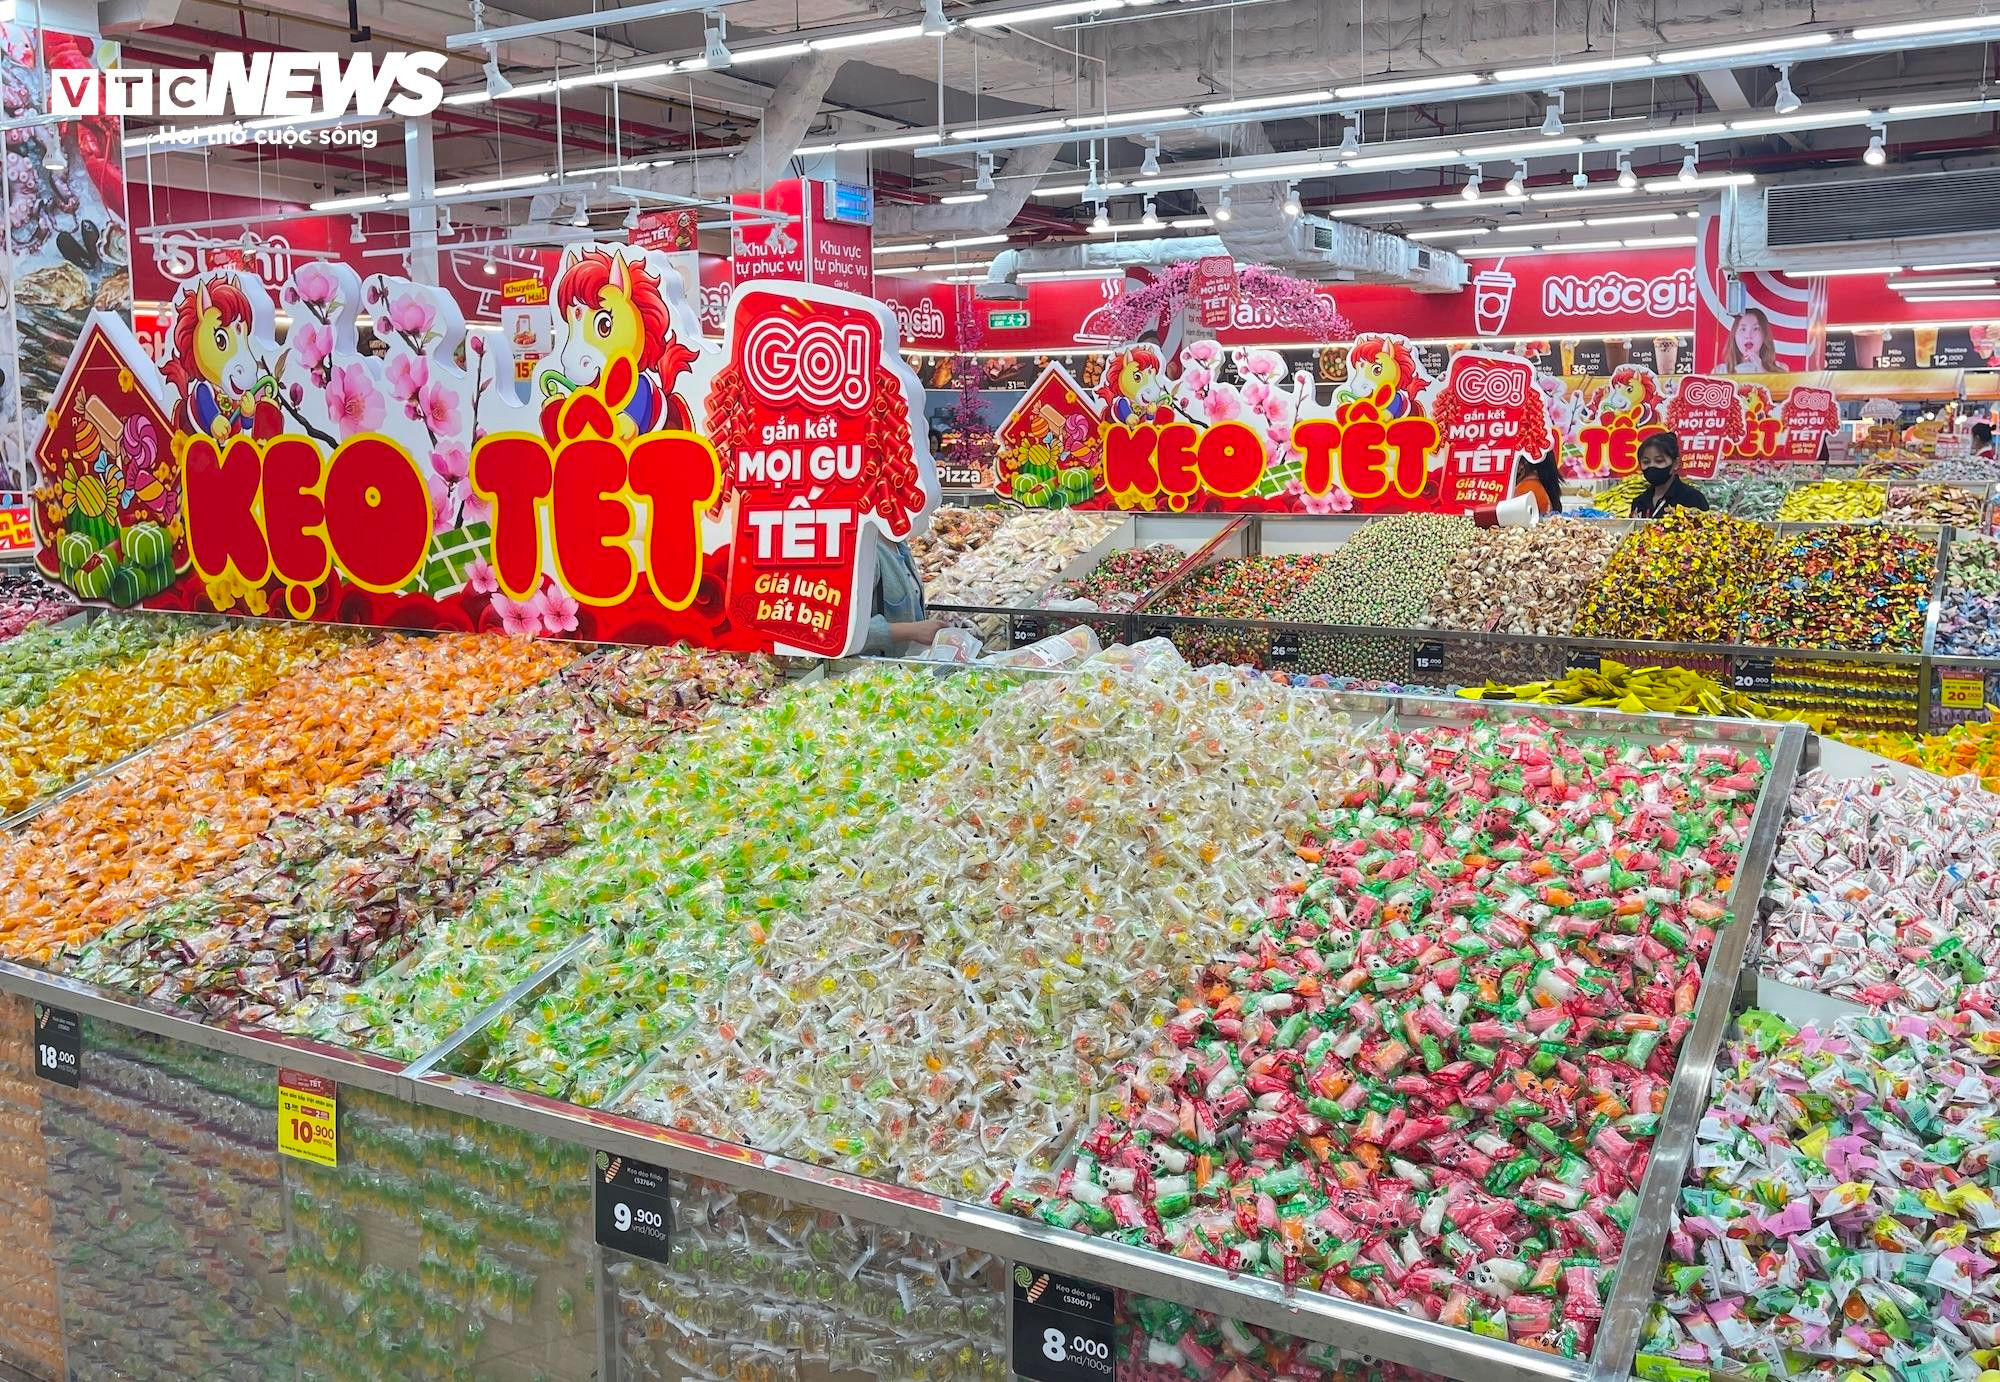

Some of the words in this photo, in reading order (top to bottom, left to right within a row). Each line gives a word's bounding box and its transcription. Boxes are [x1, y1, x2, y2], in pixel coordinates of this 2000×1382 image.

[820, 240, 840, 256] Khu
[843, 246, 861, 260] vực
[753, 259, 784, 276] phục
[787, 260, 803, 274] vụ
[815, 258, 826, 274] tự
[829, 259, 853, 277] phục
[855, 265, 868, 279] vụ
[1548, 276, 1644, 310] Nước
[744, 316, 872, 410] GO!
[1456, 365, 1526, 407] GO!
[1685, 381, 1733, 409] GO!
[1463, 409, 1485, 422] gắn
[1487, 408, 1506, 420] kết
[1678, 418, 1703, 431] MỌI
[1704, 417, 1726, 428] GU
[762, 416, 801, 446] gắn
[805, 413, 838, 440] kết
[1449, 424, 1485, 442] MỌI
[1489, 421, 1519, 438] GU
[1680, 429, 1720, 451] TẾT
[1791, 425, 1820, 441] TẾT
[1104, 420, 1267, 513] KẸO
[1293, 383, 1442, 499] TẾT
[1453, 440, 1512, 473] TẾT
[738, 450, 801, 489] MỌI
[809, 445, 862, 481] GU
[935, 466, 982, 483] Pizza
[183, 433, 434, 620] KẸO
[471, 354, 725, 612] TẾT
[1455, 479, 1476, 489] Giá
[1477, 479, 1504, 492] luôn
[1456, 489, 1477, 500] bất
[1478, 491, 1498, 504] bại
[749, 486, 852, 560] TẾT
[755, 573, 789, 595] Giá
[793, 575, 842, 606] luôn
[757, 600, 793, 622] bất
[797, 604, 832, 631] bại
[1055, 1283, 1070, 1294] Kẹo
[1063, 1295, 1093, 1309] (53007)
[1066, 1354, 1113, 1375] vnd/100gr
